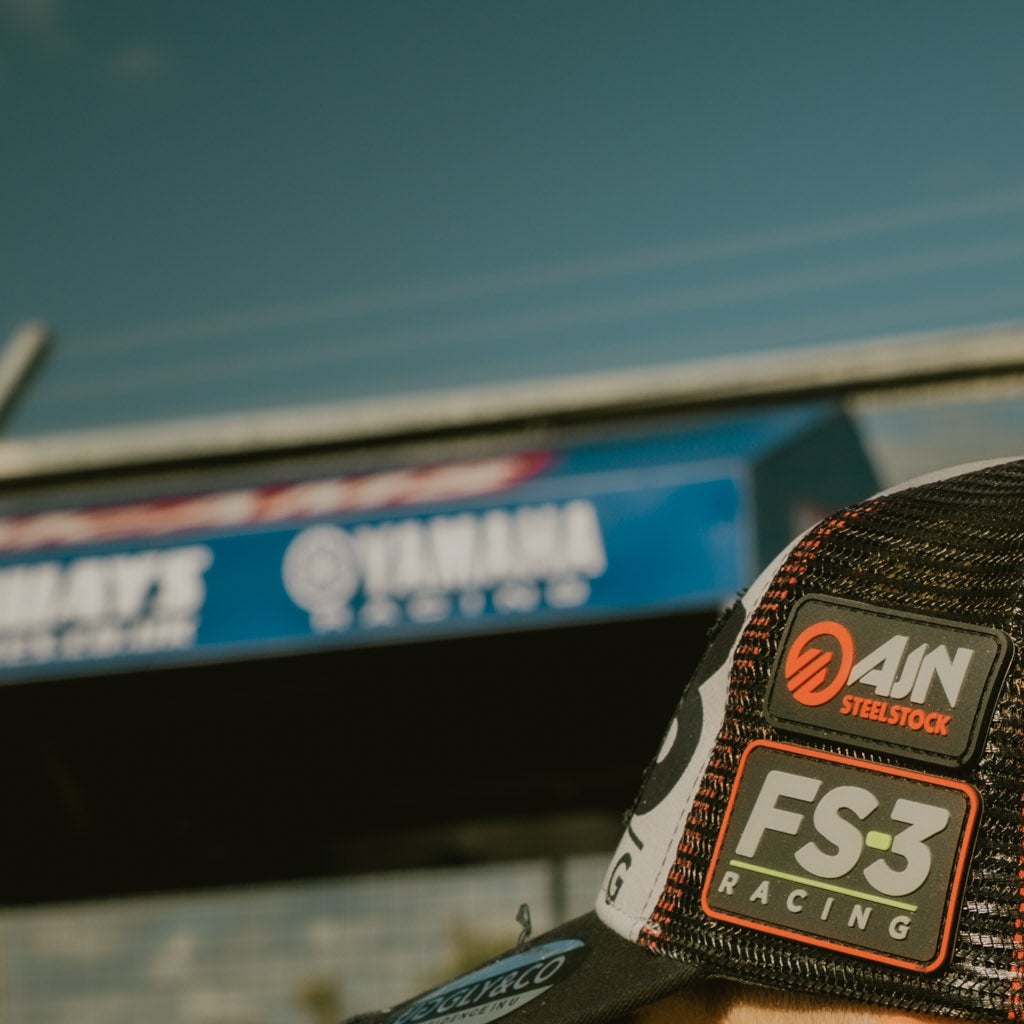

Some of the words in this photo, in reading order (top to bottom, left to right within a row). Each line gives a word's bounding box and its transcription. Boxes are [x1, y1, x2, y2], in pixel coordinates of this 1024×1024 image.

[354, 499, 608, 601] YAMAHA
[847, 634, 975, 709] AJN
[840, 694, 952, 736] STEELSTOCK
[735, 769, 951, 897] FS-3
[717, 870, 912, 940] RACING
